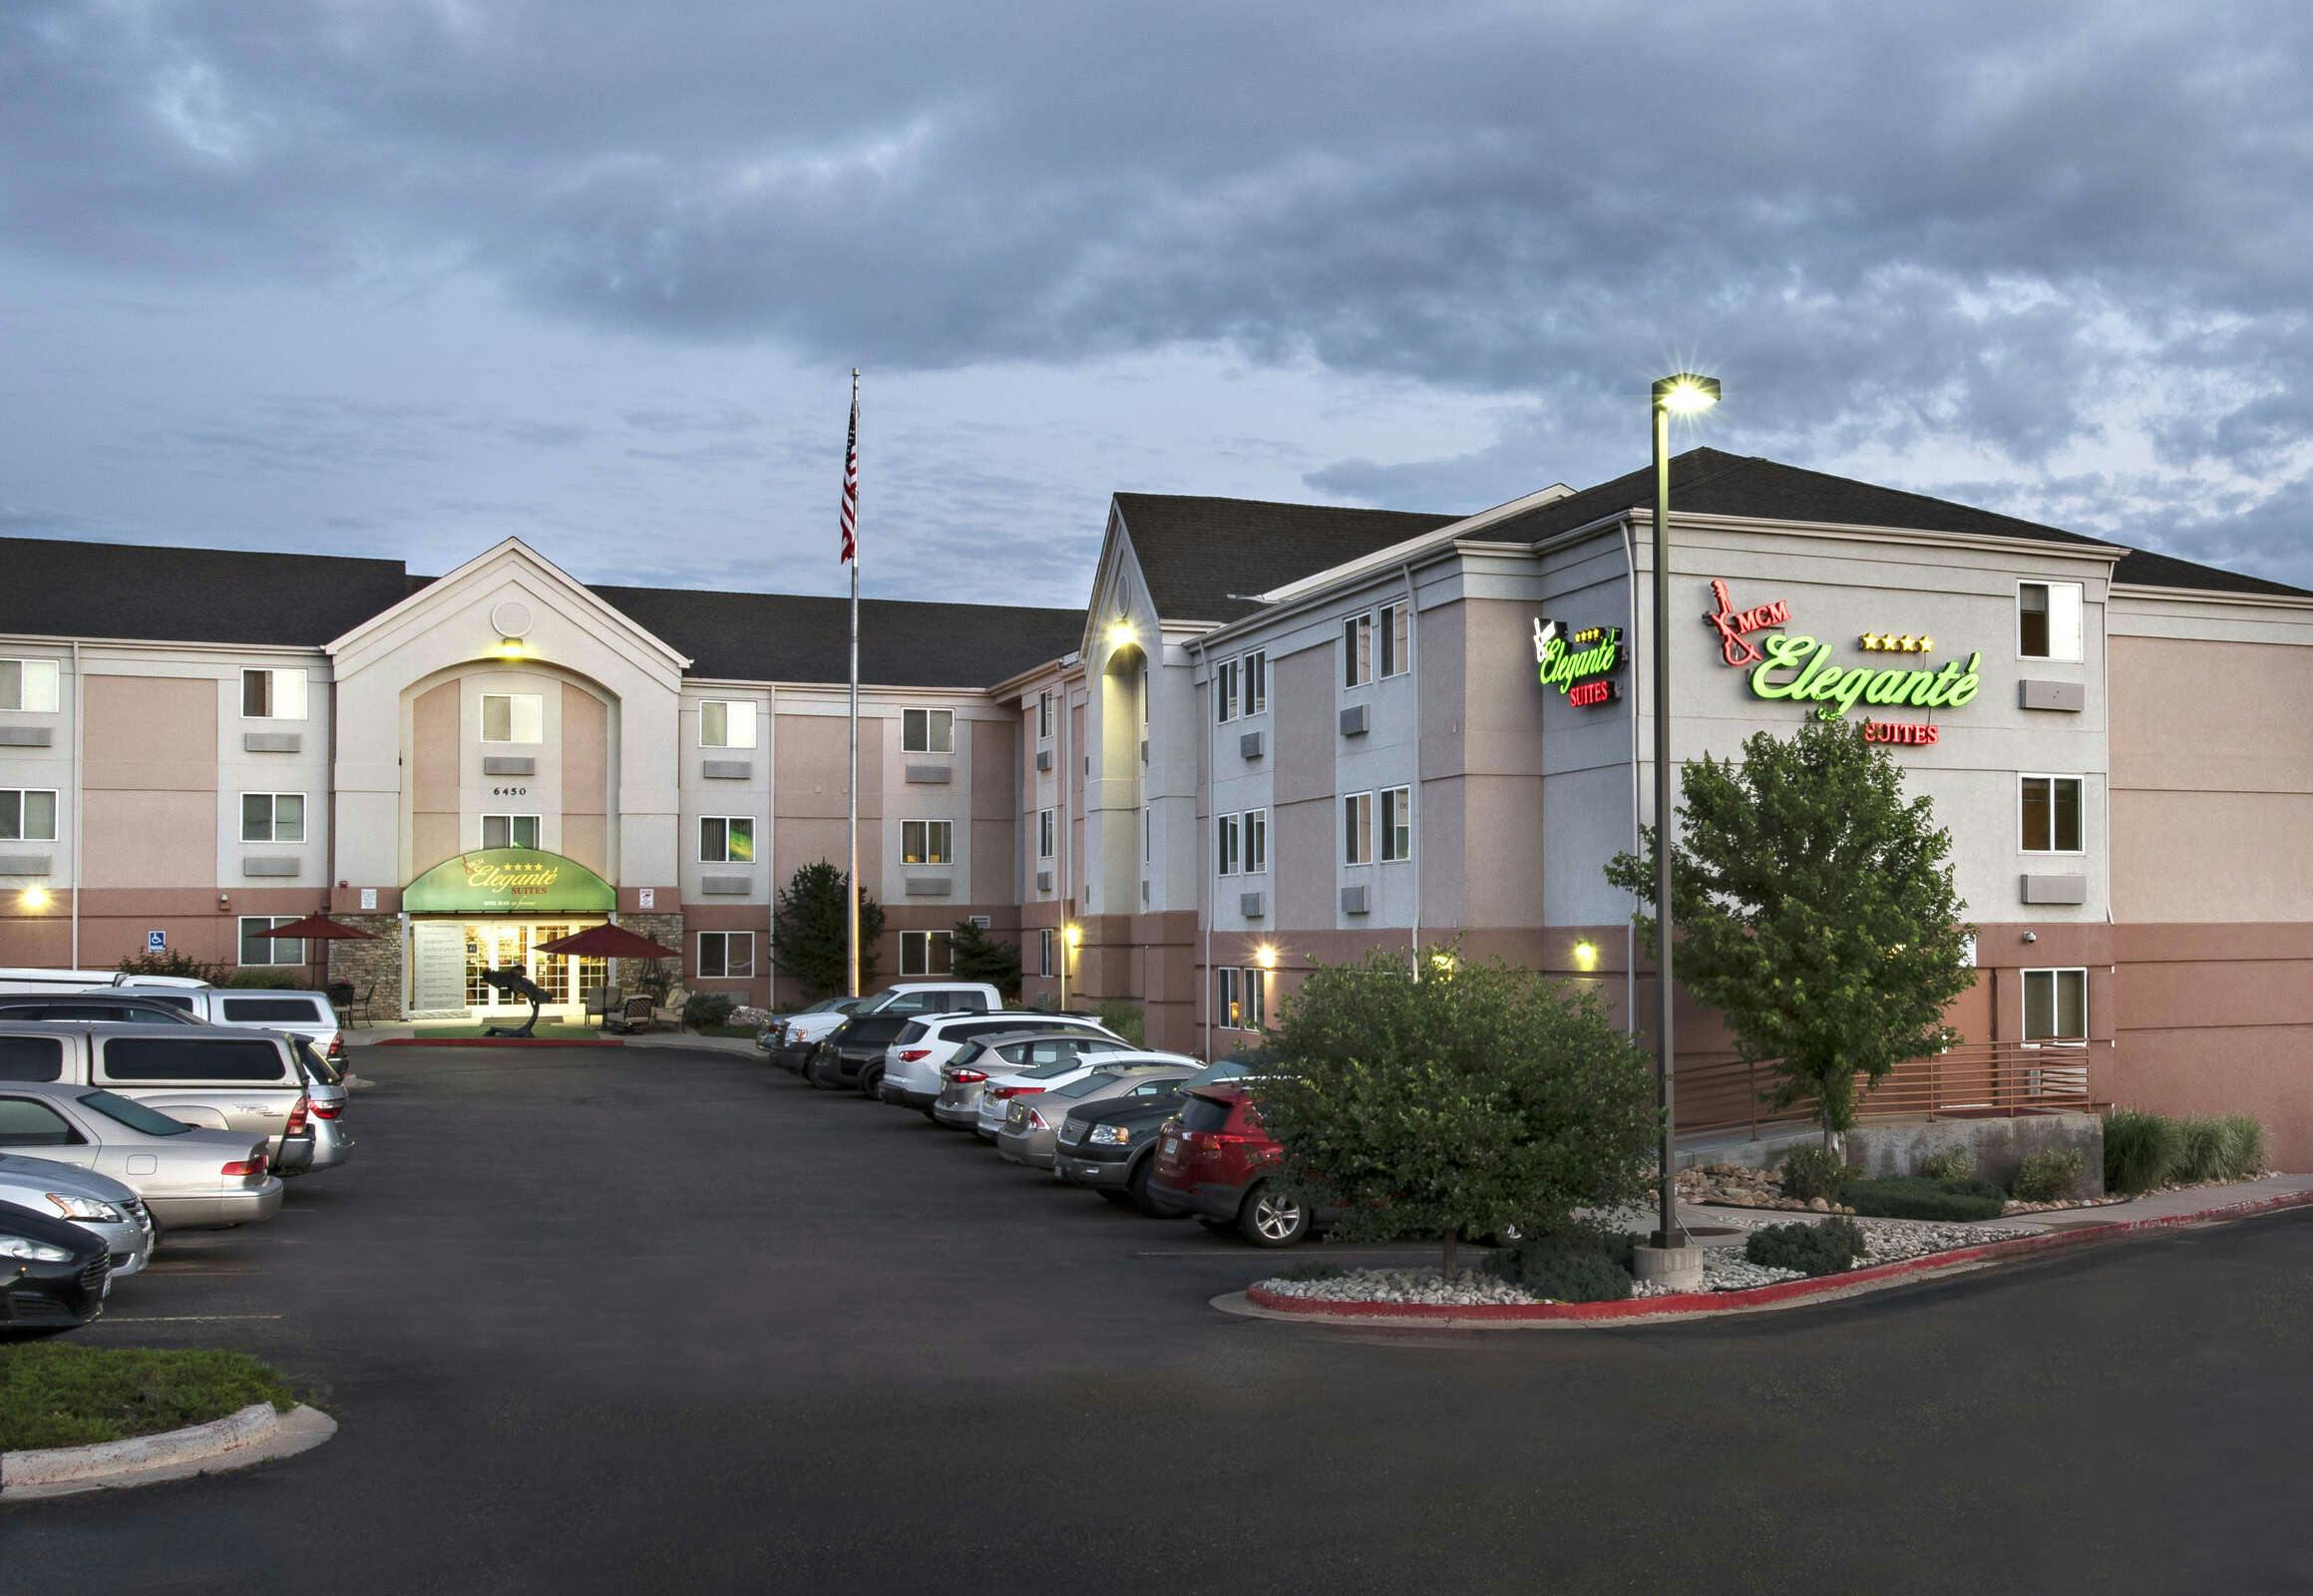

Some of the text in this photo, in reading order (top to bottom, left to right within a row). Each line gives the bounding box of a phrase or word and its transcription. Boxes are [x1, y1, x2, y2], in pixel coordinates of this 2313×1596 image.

[1735, 599, 1792, 634] MCM
[1540, 627, 1615, 694] Eleganté
[1749, 633, 1982, 721] Eleganté
[1569, 679, 1609, 707] SUITES
[1865, 722, 1939, 744] SUITES
[493, 787, 527, 796] 6450
[467, 865, 559, 893] Eleganté
